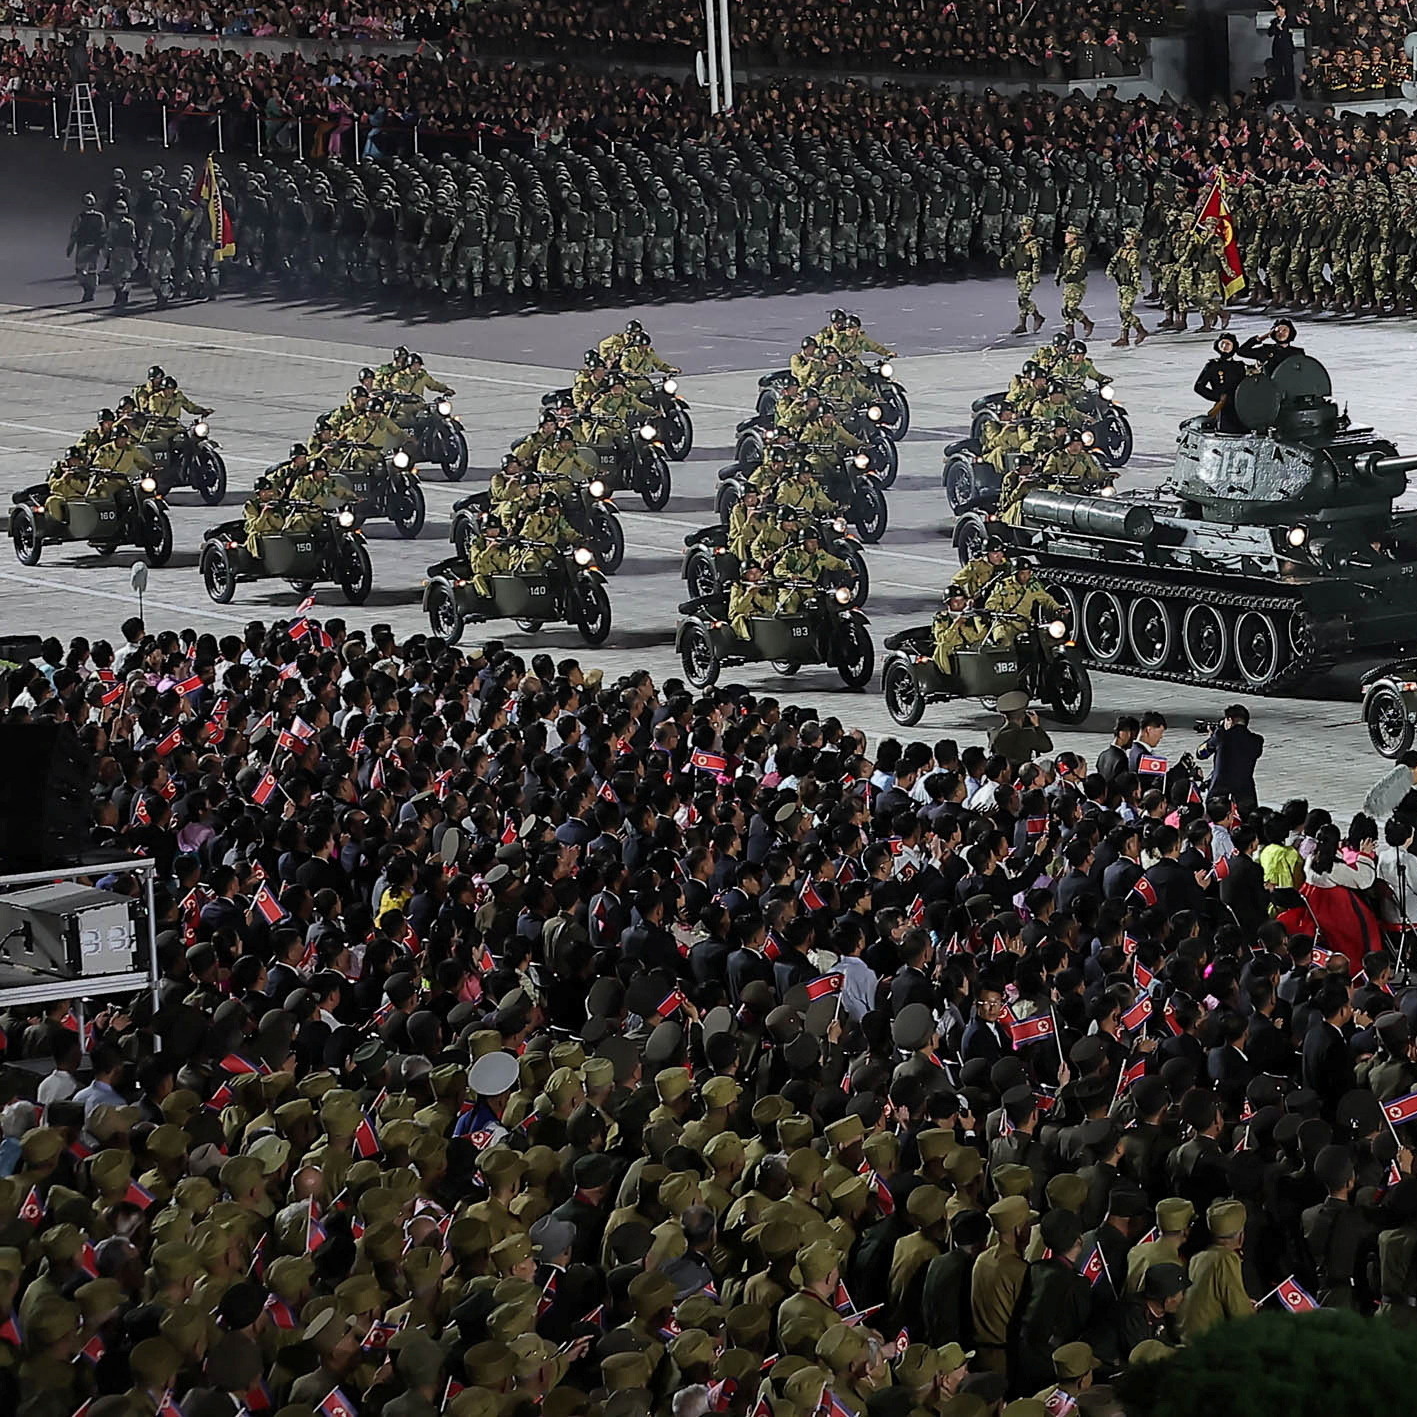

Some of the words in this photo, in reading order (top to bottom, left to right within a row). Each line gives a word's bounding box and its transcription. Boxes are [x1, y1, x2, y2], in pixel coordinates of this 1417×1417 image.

[155, 451, 168, 460] 171
[296, 542, 312, 552] 150
[530, 586, 546, 595] 140
[792, 627, 809, 637] 183
[996, 662, 1014, 673] 182
